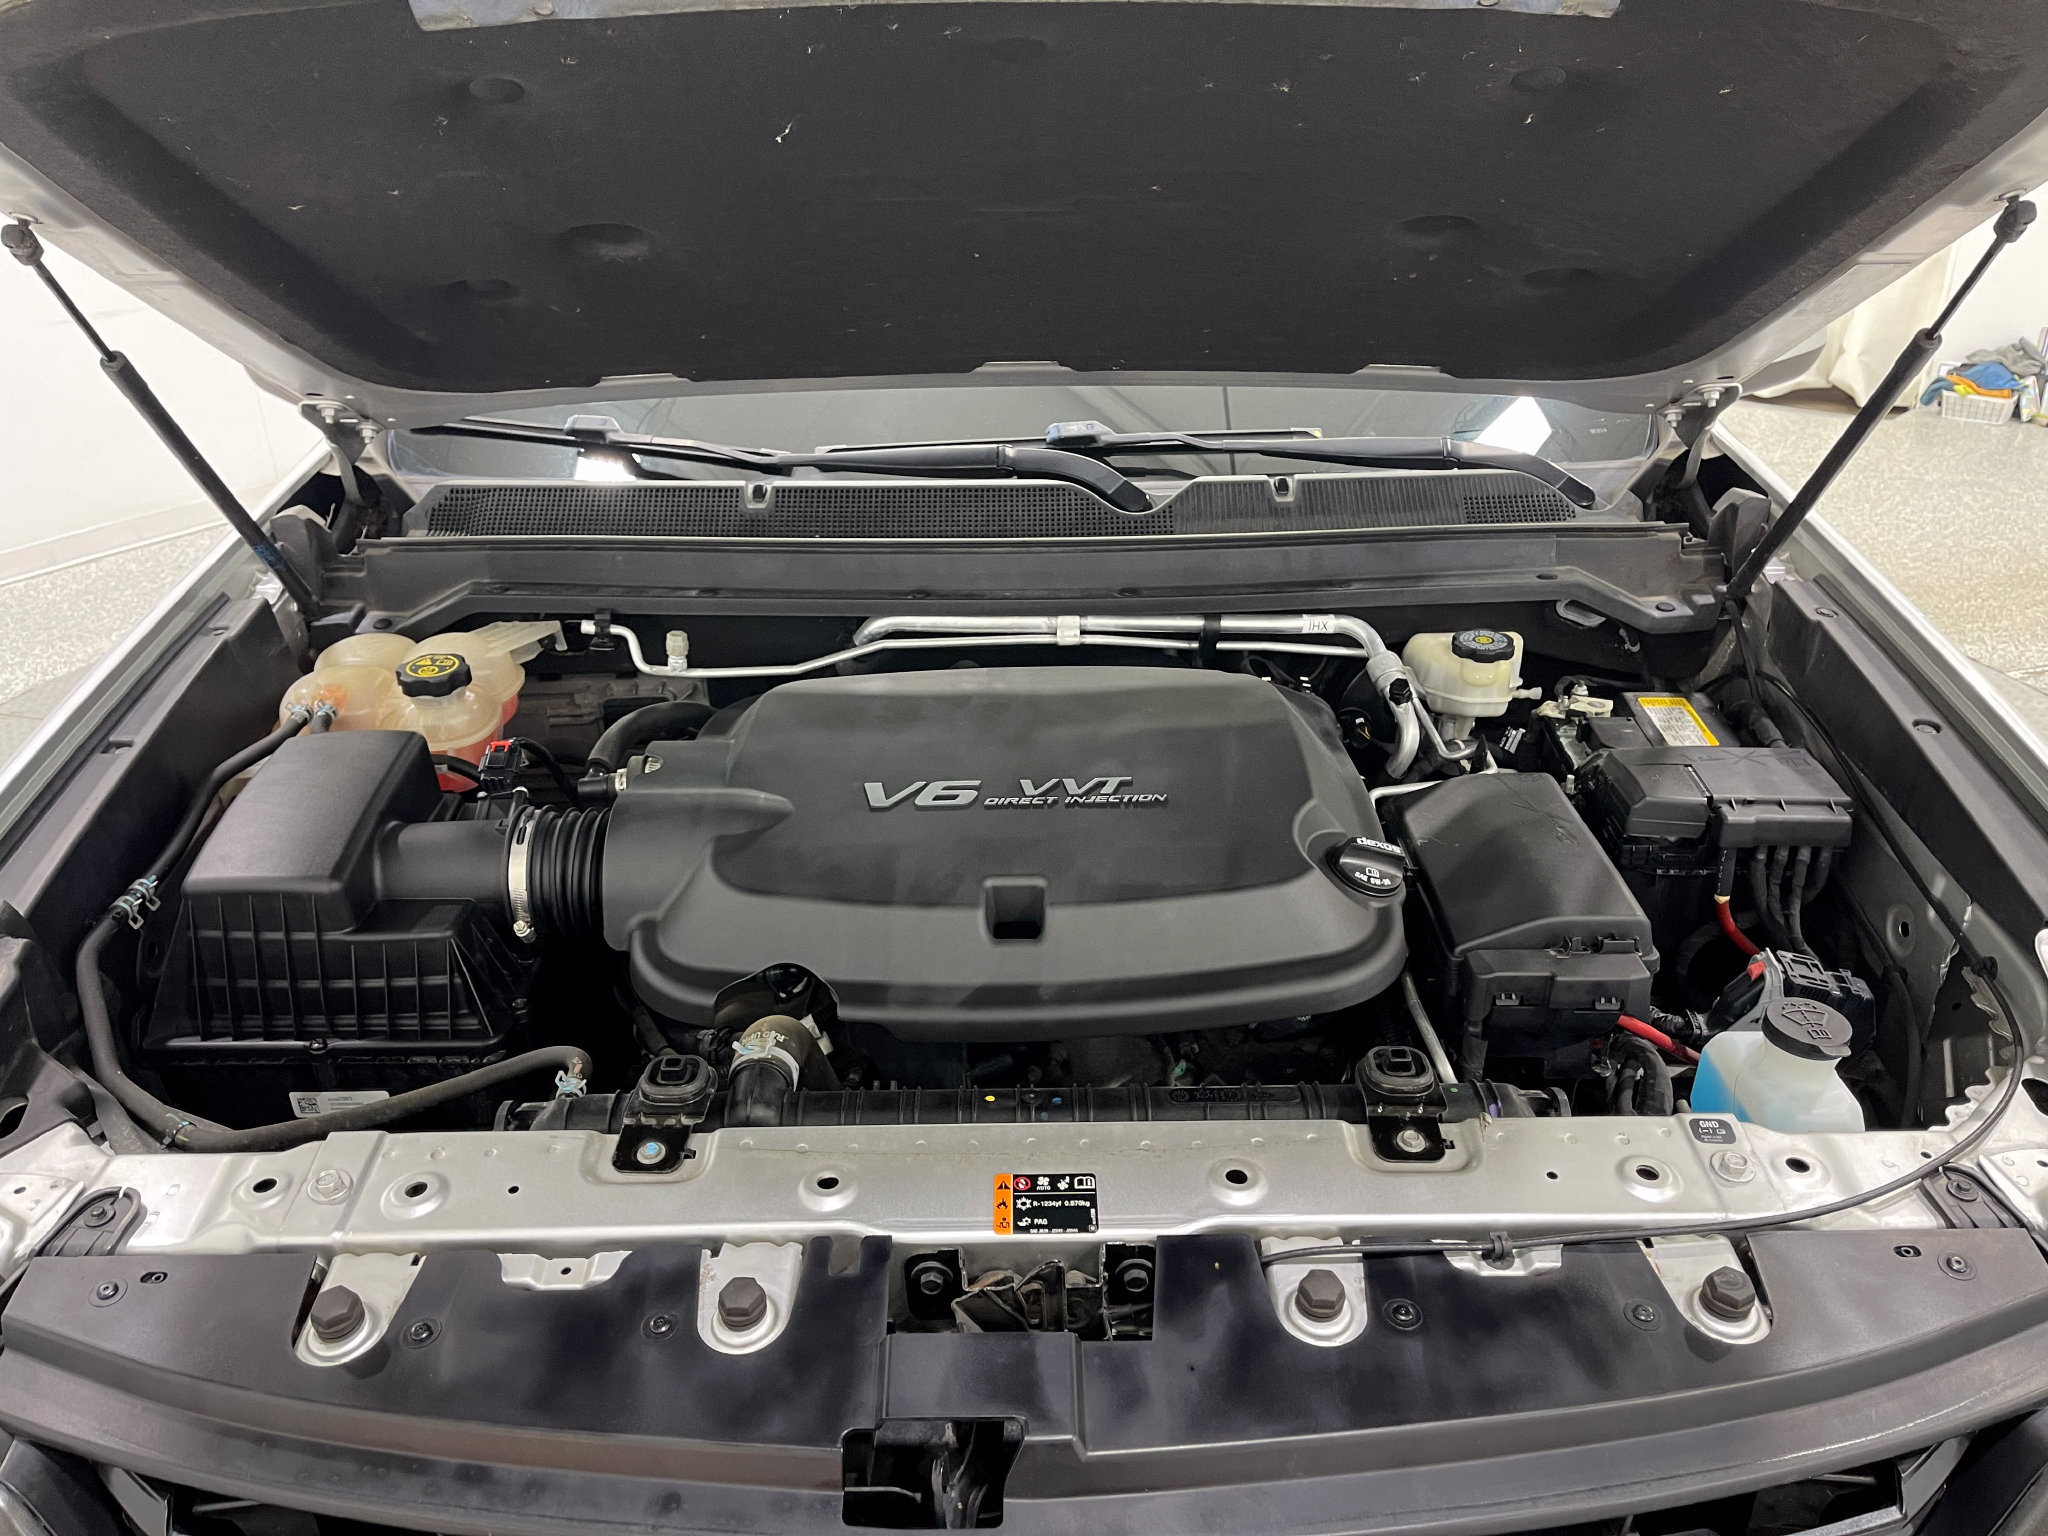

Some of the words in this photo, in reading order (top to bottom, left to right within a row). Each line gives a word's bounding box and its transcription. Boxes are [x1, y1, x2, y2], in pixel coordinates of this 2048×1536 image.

[863, 780, 982, 809] V6
[1018, 776, 1133, 797] VVT
[983, 796, 1058, 806] DIRECT
[1064, 793, 1168, 804] INJECTION
[1356, 836, 1402, 854] dexos
[1354, 871, 1369, 882] SAE
[1699, 1120, 1720, 1128] GND
[1033, 1218, 1048, 1226] PAG
